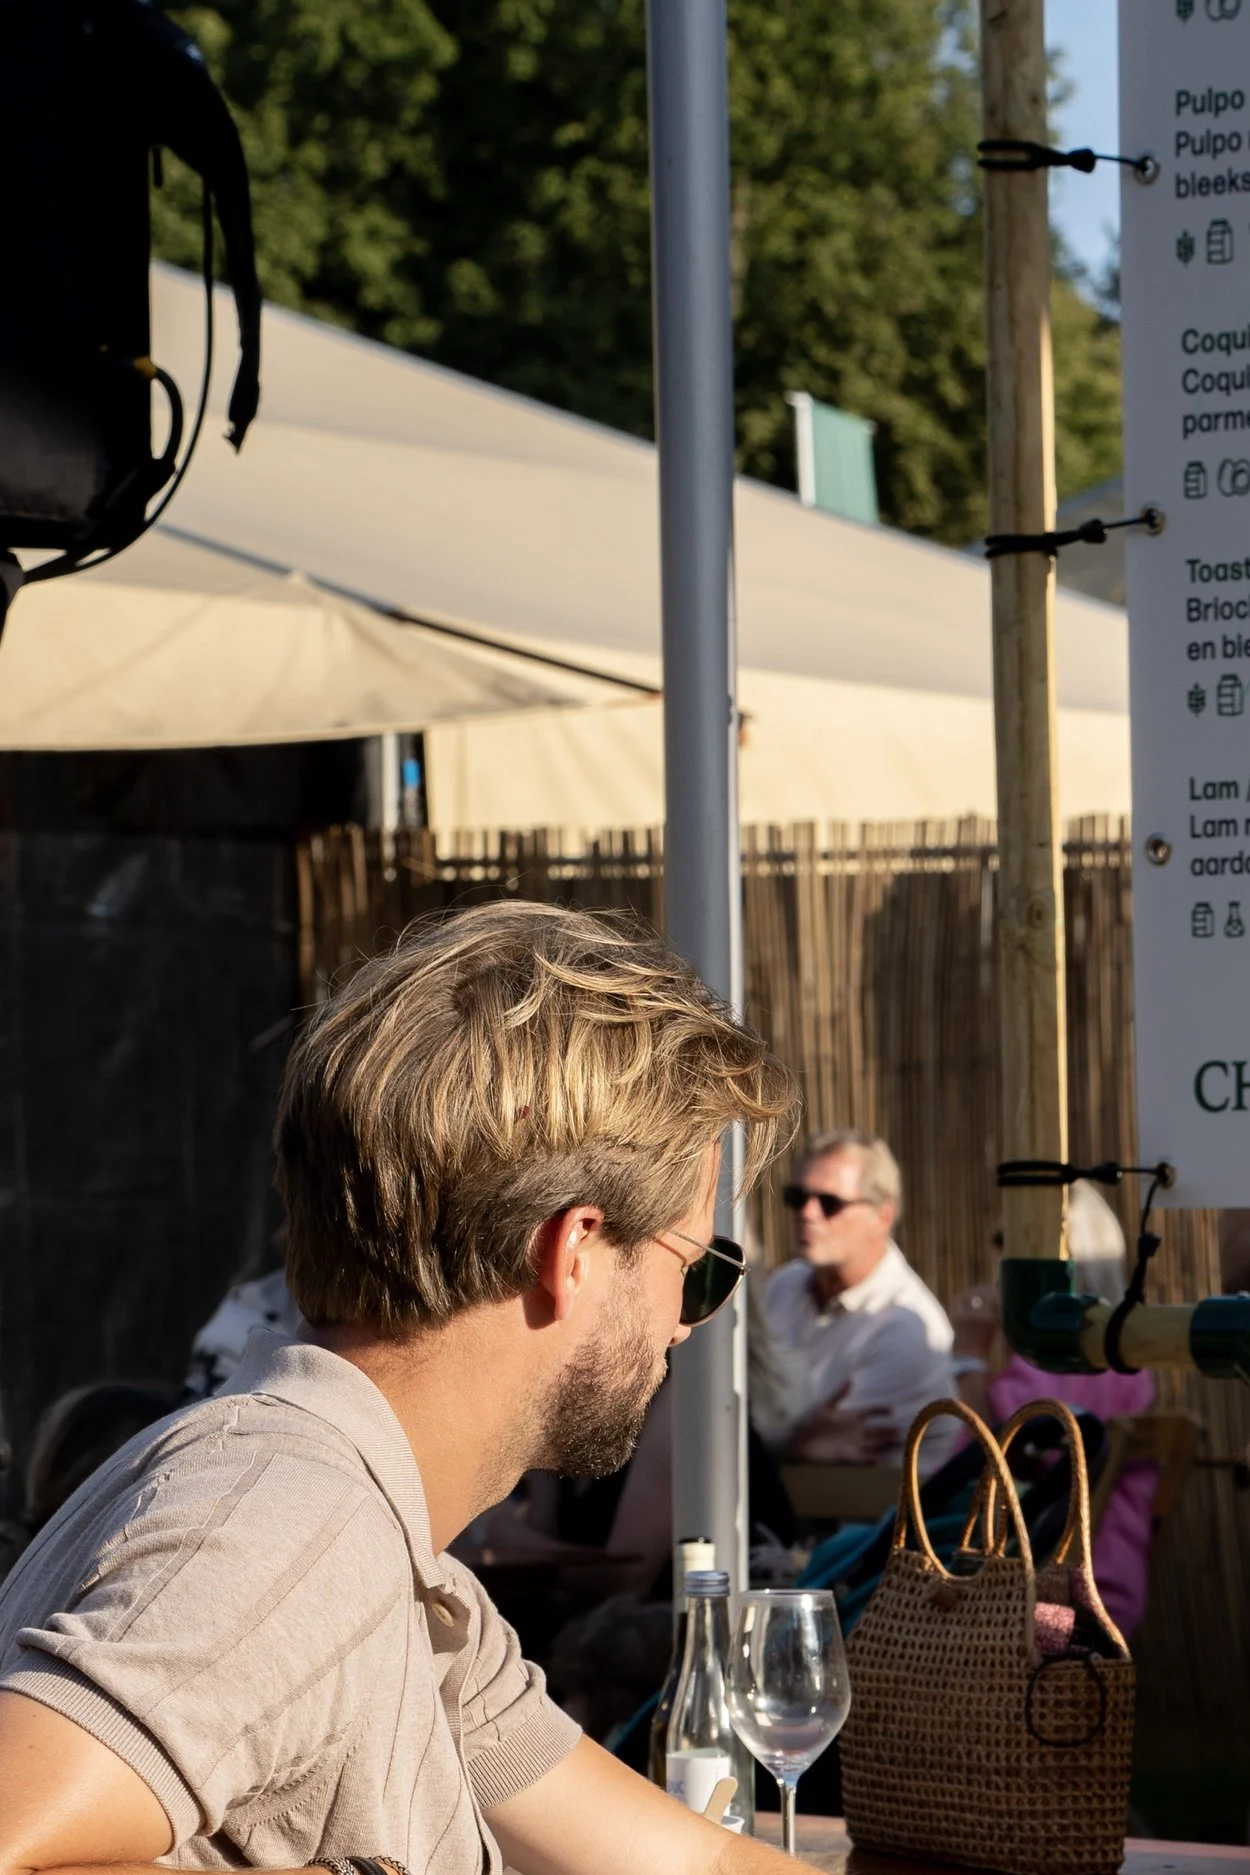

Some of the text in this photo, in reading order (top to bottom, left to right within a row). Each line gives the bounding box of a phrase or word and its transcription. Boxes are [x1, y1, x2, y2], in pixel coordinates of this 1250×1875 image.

[1175, 87, 1245, 118] Pulpo
[1175, 129, 1242, 160] Pulpo
[1186, 641, 1216, 662] en
[1189, 777, 1239, 801] Lam
[1190, 815, 1238, 839] Lam
